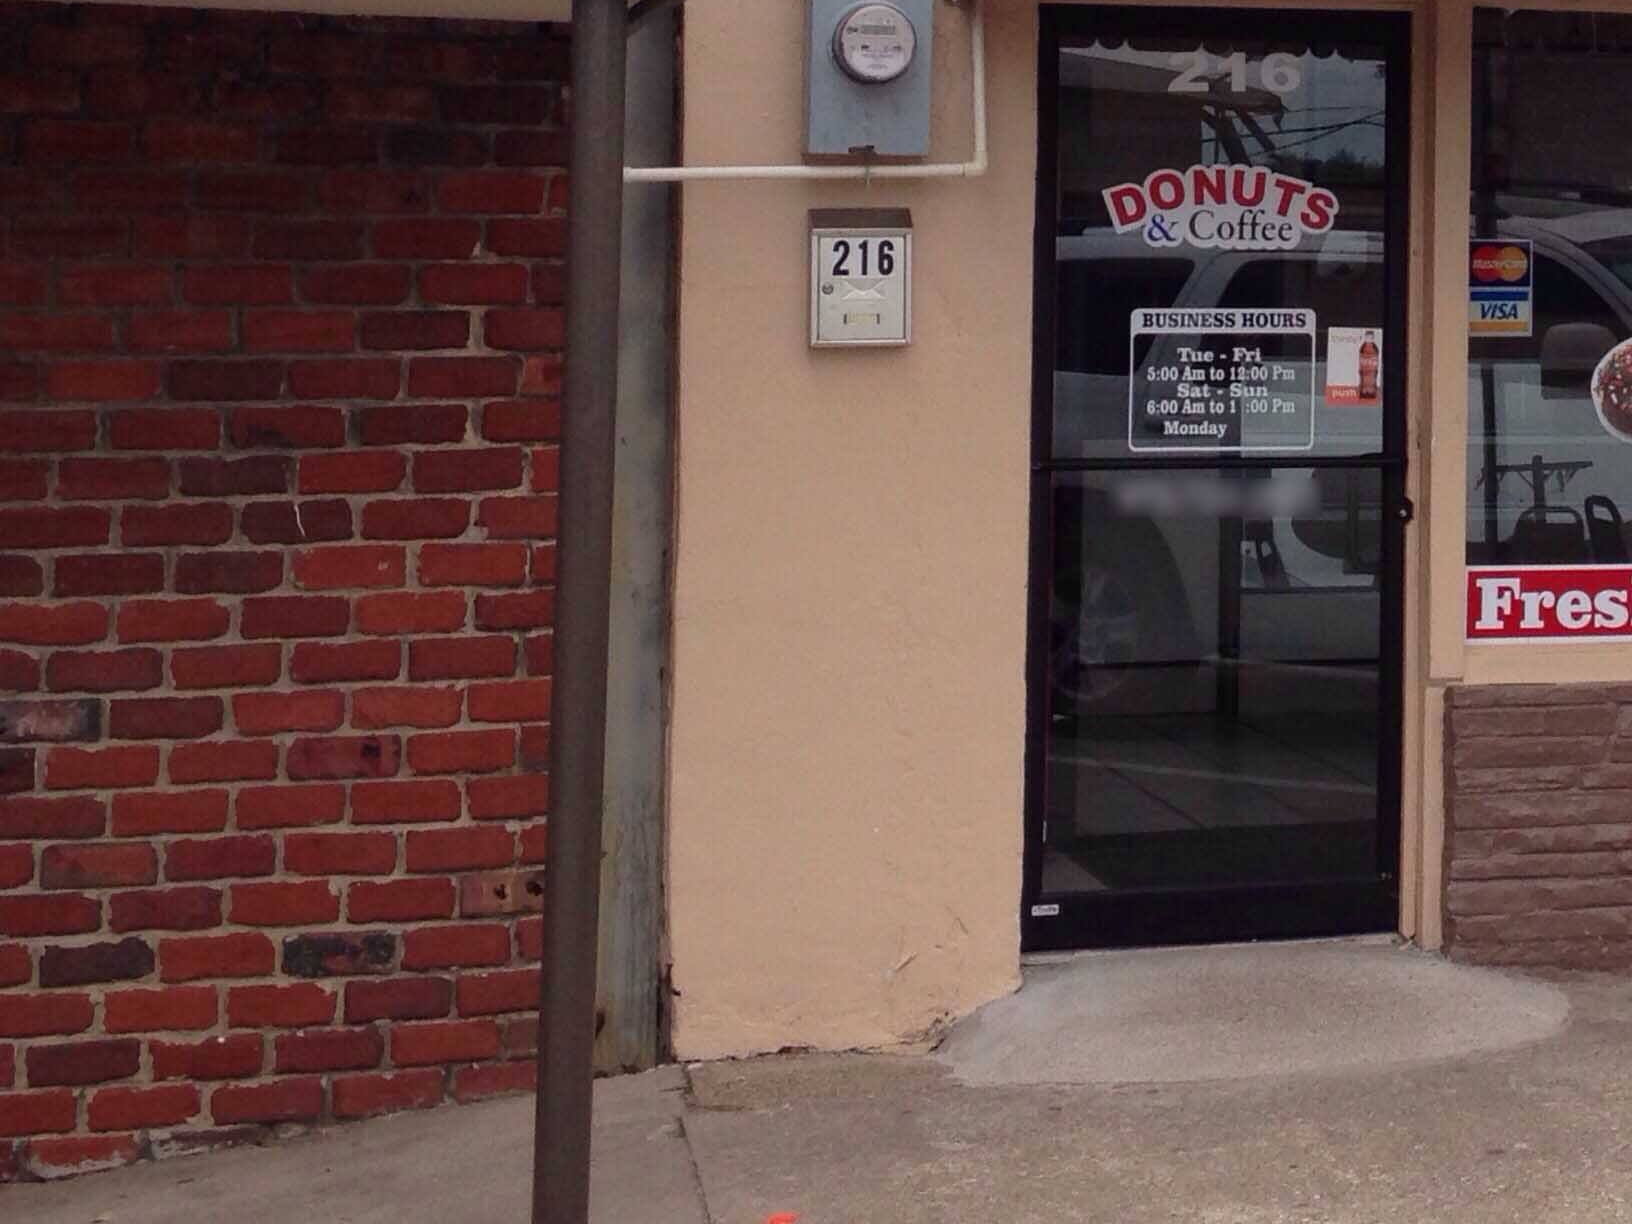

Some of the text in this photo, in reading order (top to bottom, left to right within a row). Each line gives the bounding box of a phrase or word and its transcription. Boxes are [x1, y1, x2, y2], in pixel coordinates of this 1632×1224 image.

[1168, 52, 1301, 93] 216
[1110, 169, 1334, 229] DONUTS
[1147, 209, 1293, 241] & Coffee
[832, 239, 895, 276] 216
[1480, 303, 1519, 320] VISA
[1143, 313, 1307, 328] BUSINESS HOURS
[1177, 347, 1214, 363] Tue
[1232, 347, 1262, 362] Fri
[1147, 365, 1296, 381] 5:00 Am to 12:00 Pm
[1177, 383, 1211, 398] Sat
[1230, 383, 1268, 398] Sun
[1147, 400, 1178, 414] 6:00
[1182, 400, 1206, 414] Am
[1209, 400, 1225, 414] to
[1272, 399, 1296, 414] Pm
[1163, 421, 1228, 438] Monday
